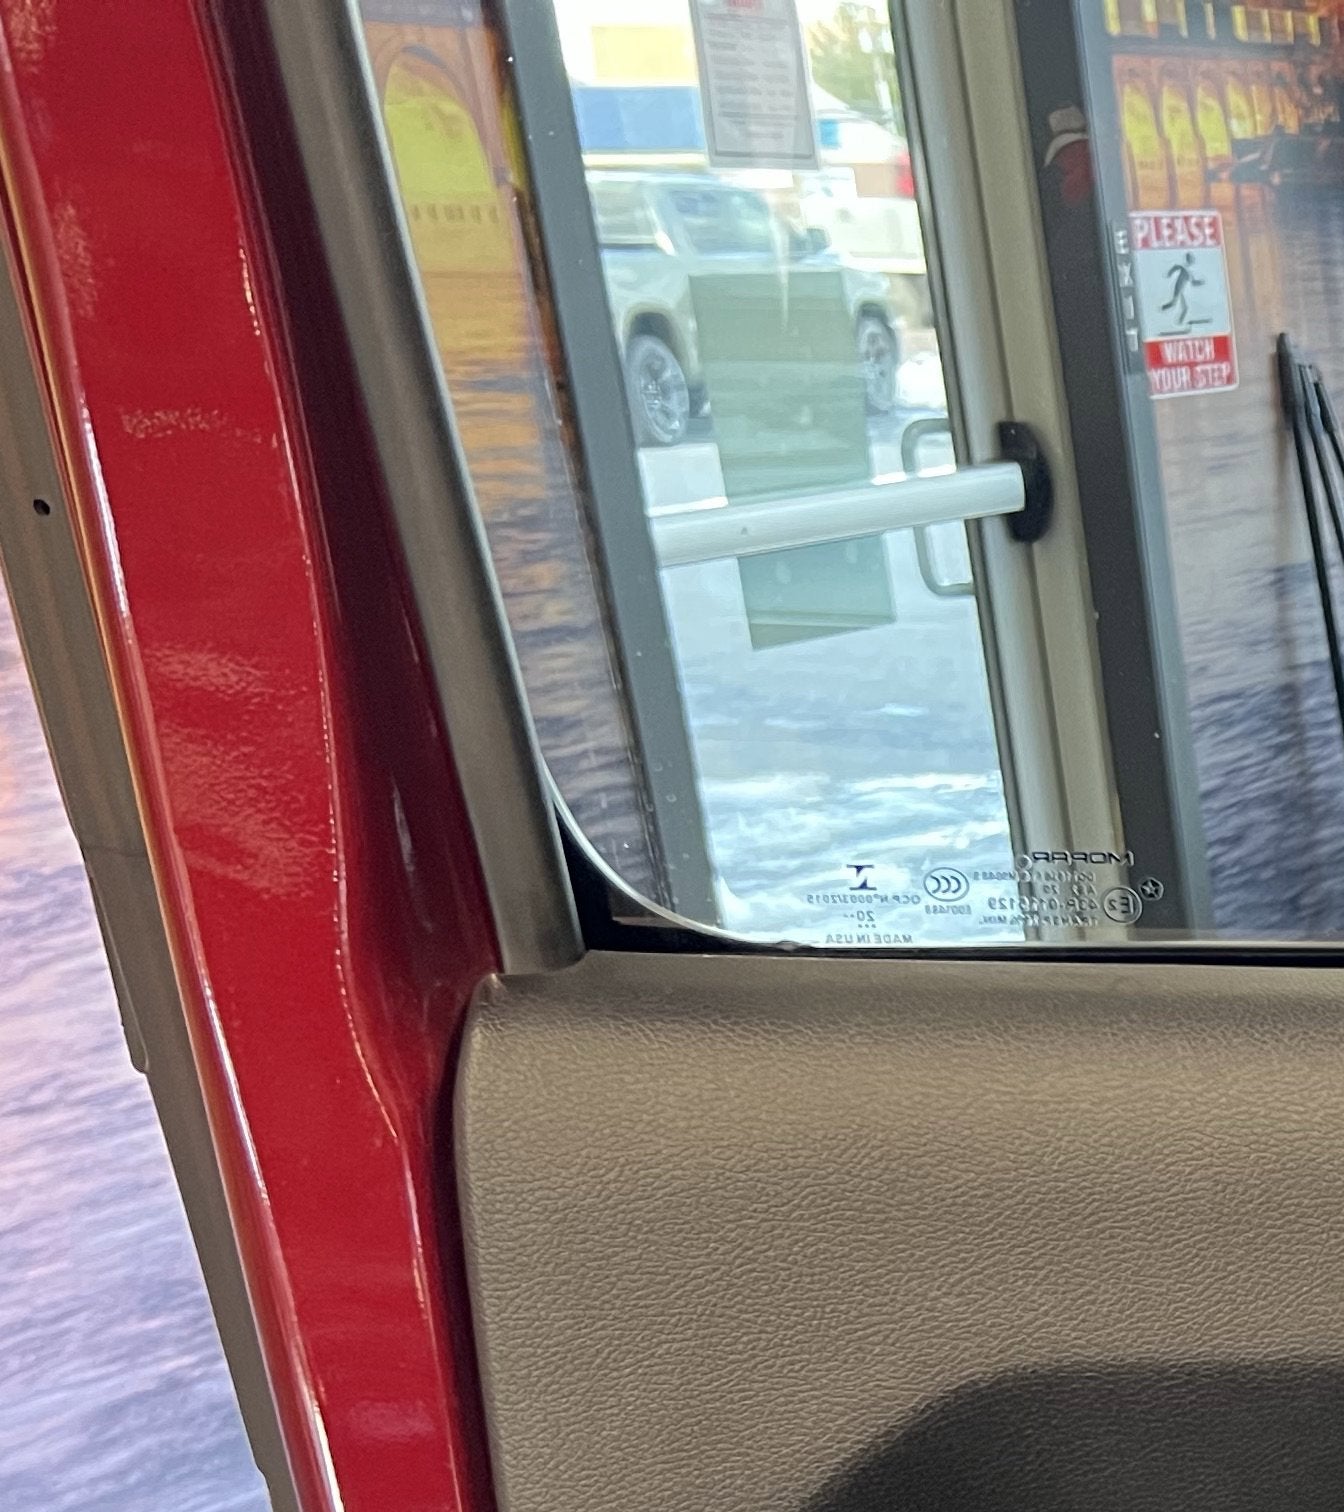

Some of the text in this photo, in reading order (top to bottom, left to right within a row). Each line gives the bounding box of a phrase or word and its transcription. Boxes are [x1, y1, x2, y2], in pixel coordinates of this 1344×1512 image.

[1132, 215, 1218, 249] PLEASE
[1161, 339, 1216, 364] WATCH
[1151, 362, 1231, 392] YOUR STEP
